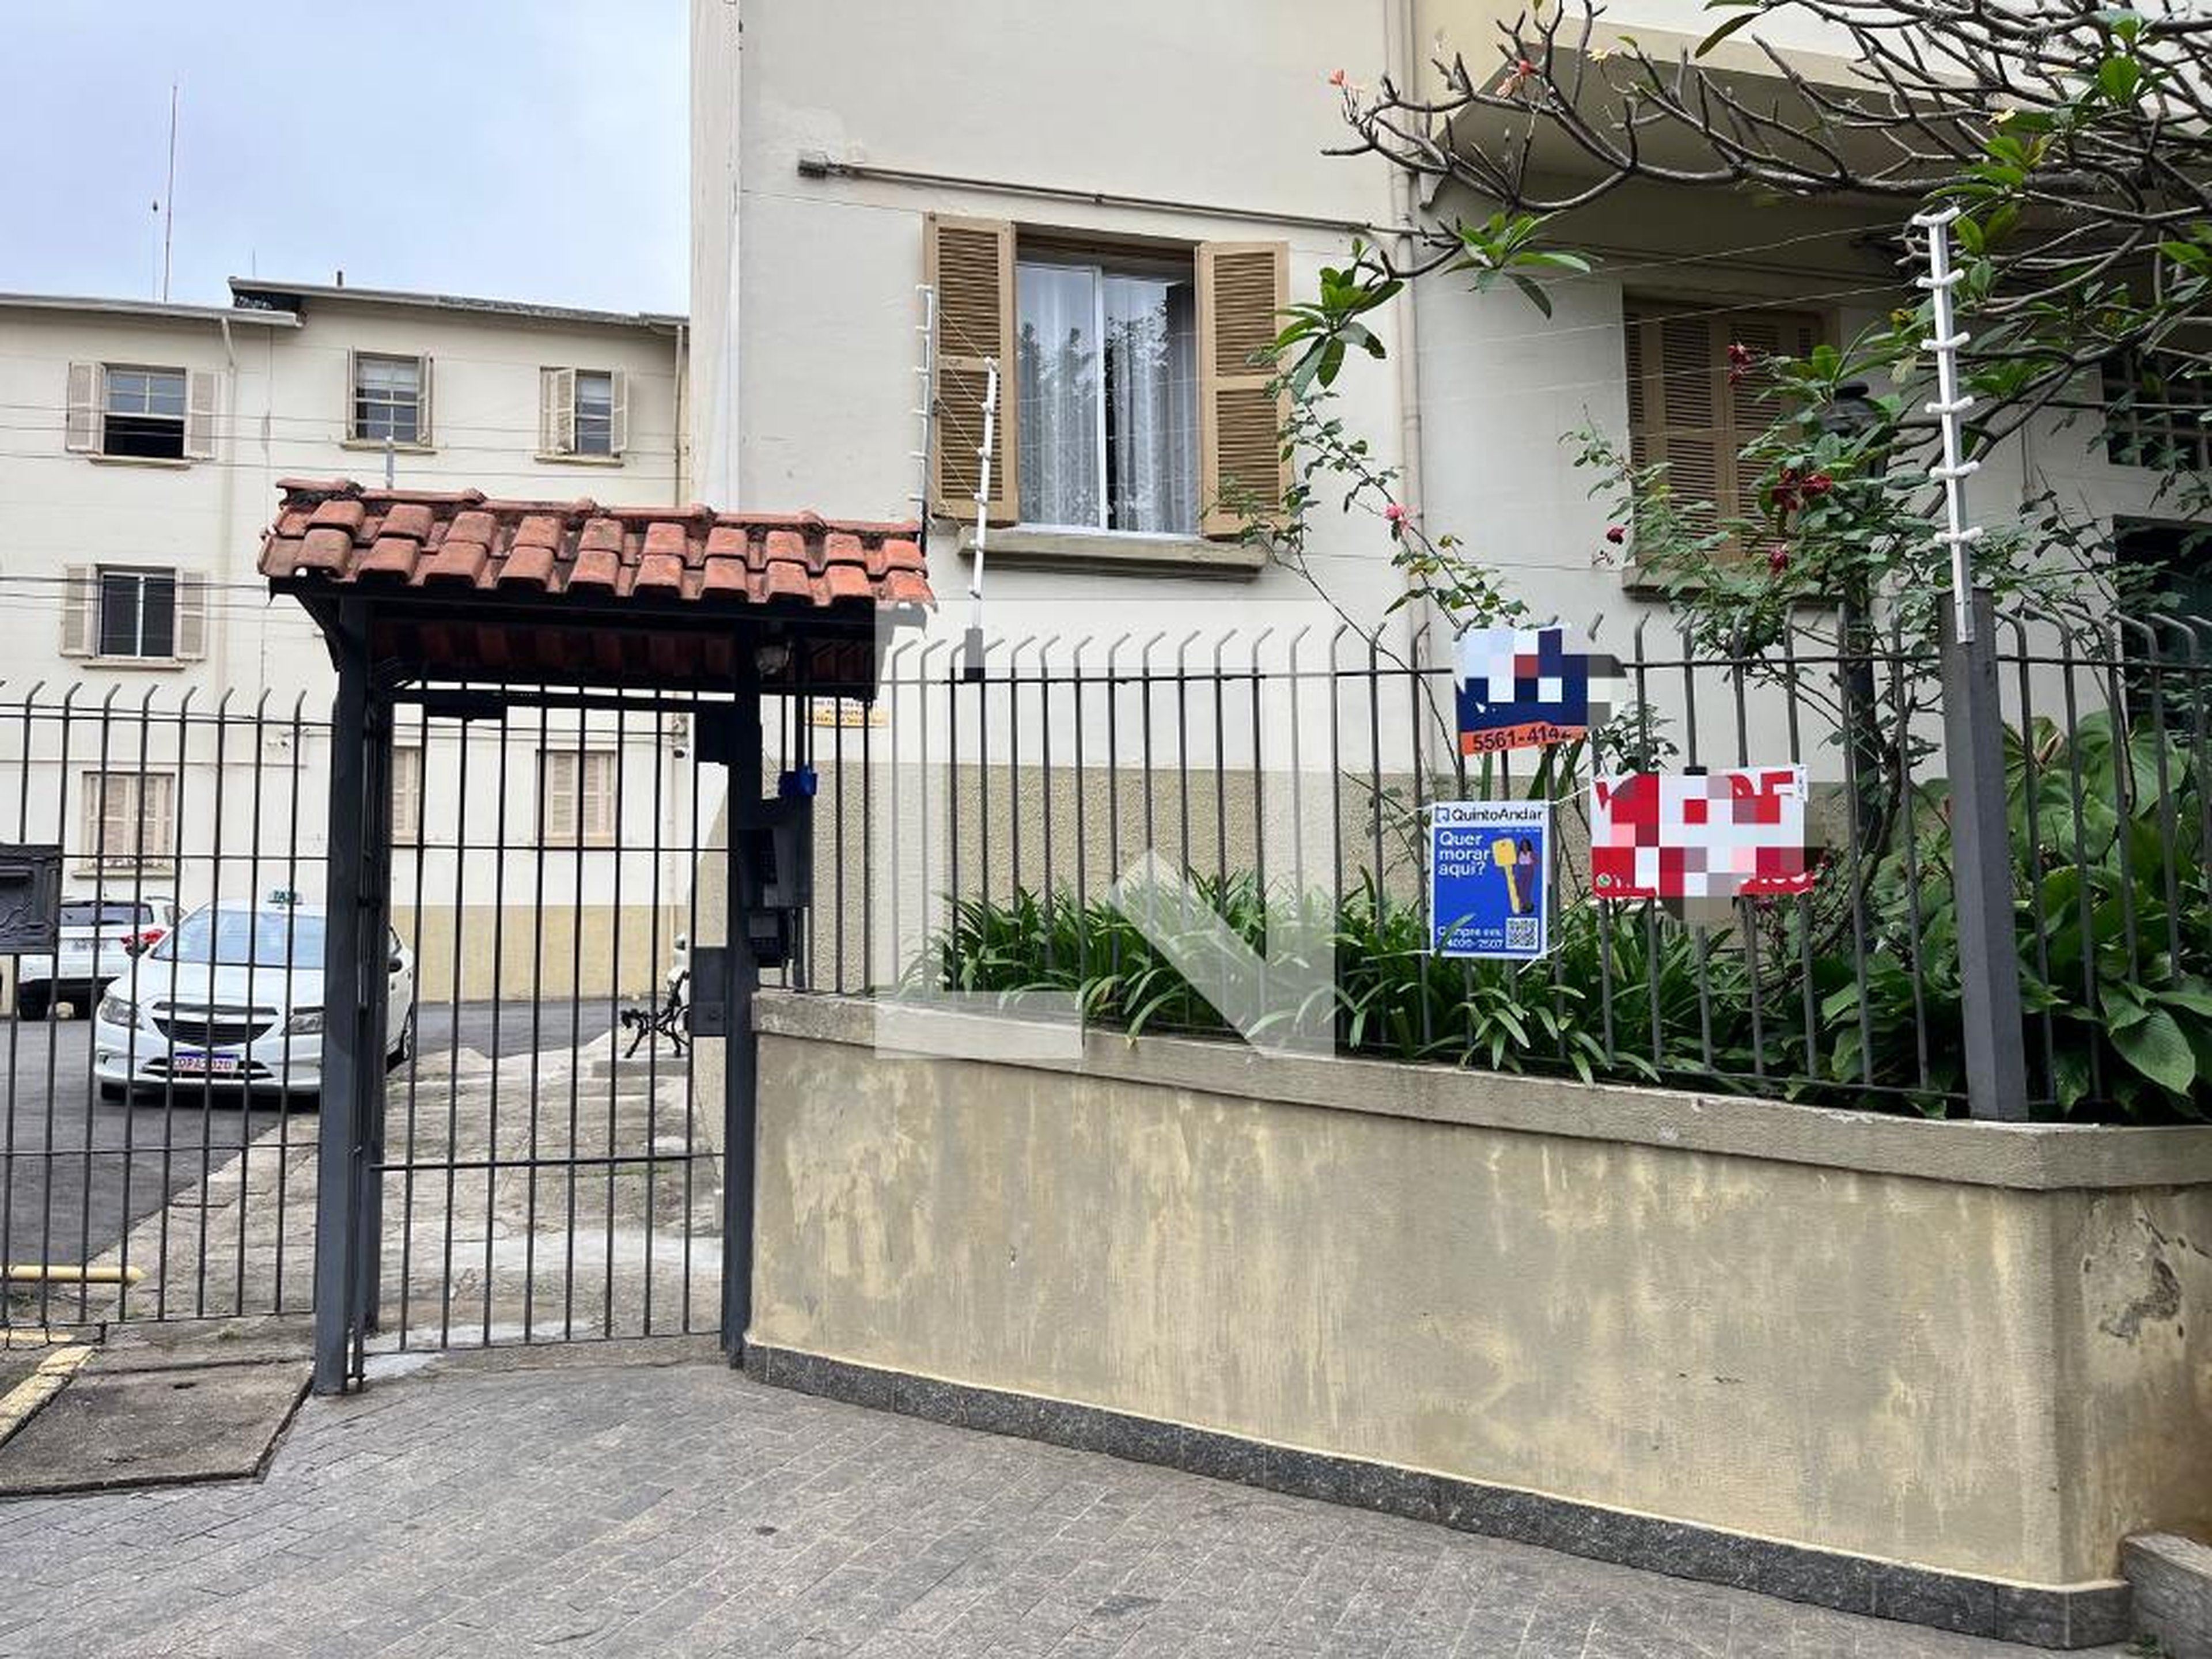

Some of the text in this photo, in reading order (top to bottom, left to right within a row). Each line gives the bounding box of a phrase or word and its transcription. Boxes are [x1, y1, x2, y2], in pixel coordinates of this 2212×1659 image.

[1452, 807, 1543, 821] QuintoAndar
[1440, 831, 1483, 846] Quer
[1440, 849, 1491, 861] morar
[1438, 862, 1486, 878] aqui?
